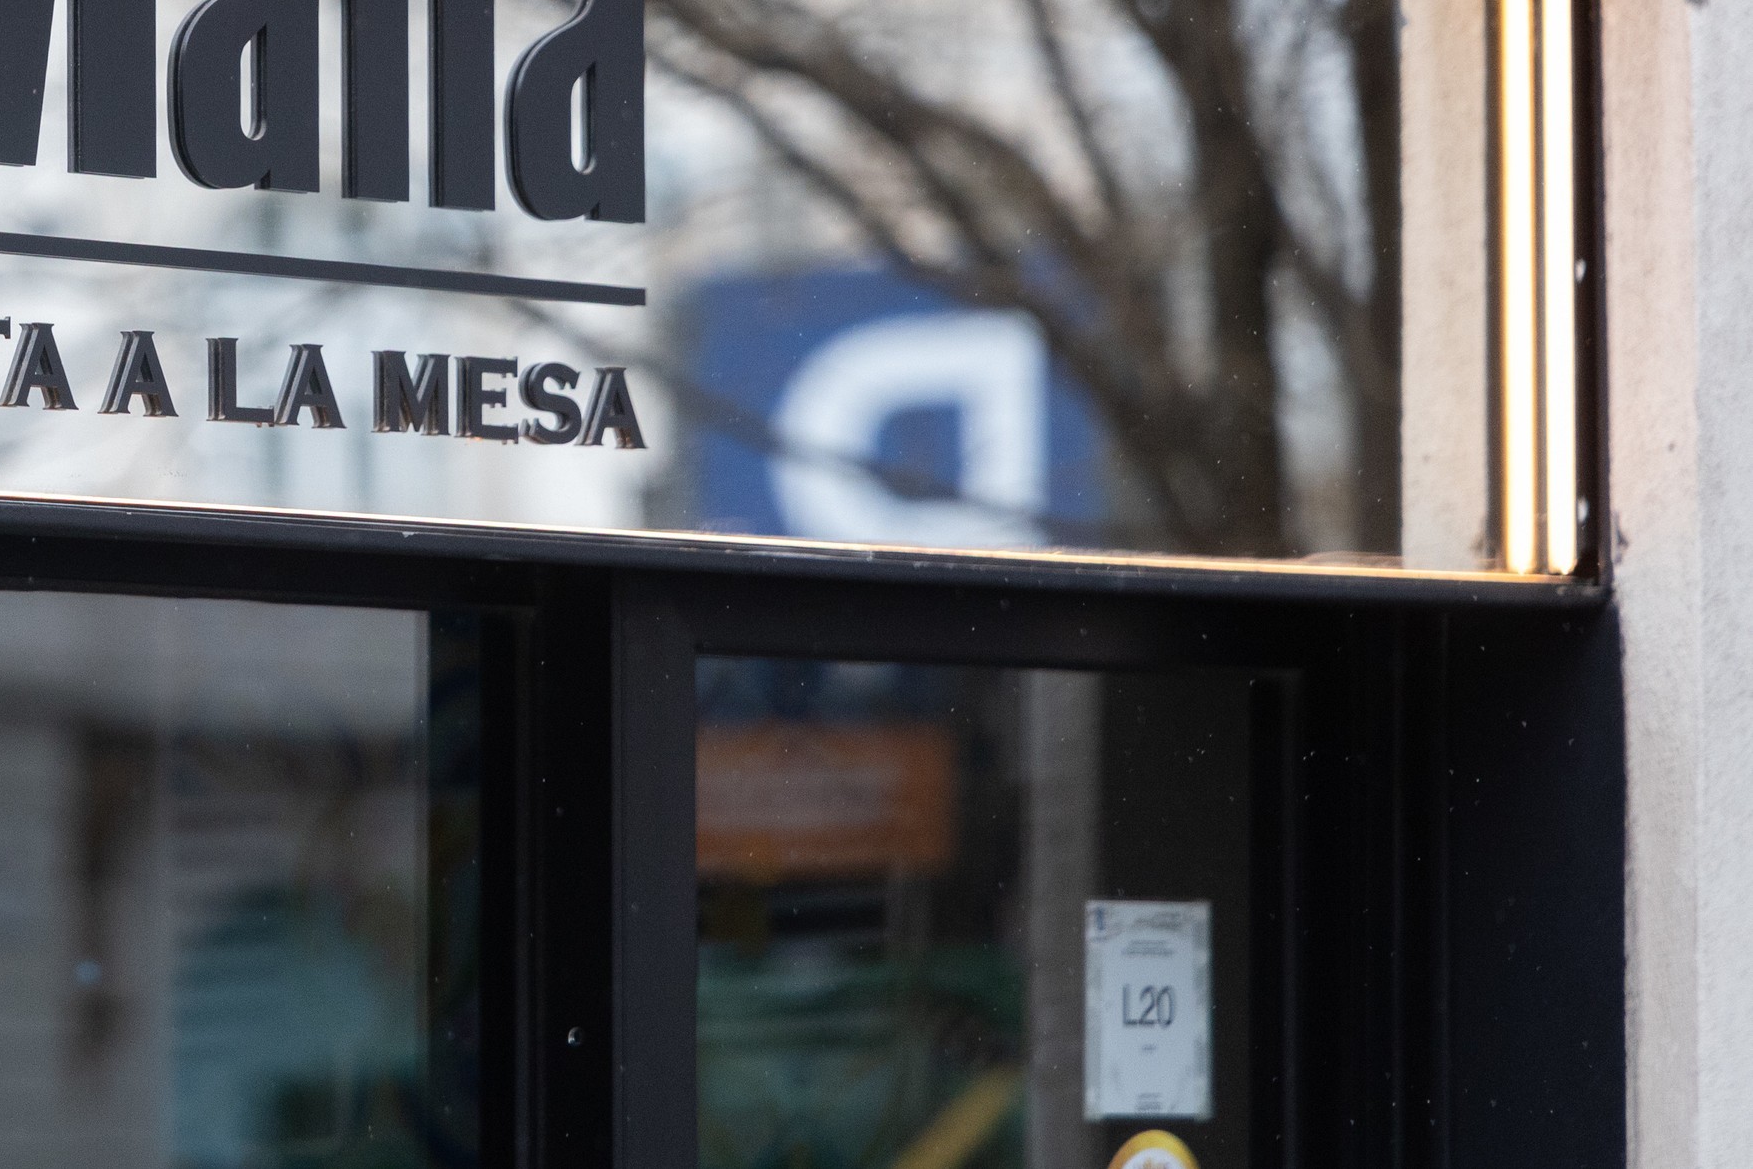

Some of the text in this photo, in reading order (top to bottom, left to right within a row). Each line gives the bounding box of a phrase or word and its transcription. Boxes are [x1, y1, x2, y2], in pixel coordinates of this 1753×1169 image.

[97, 330, 179, 418] A
[206, 337, 347, 429] LA
[371, 349, 649, 449] MESA
[1121, 984, 1176, 1028] L20
